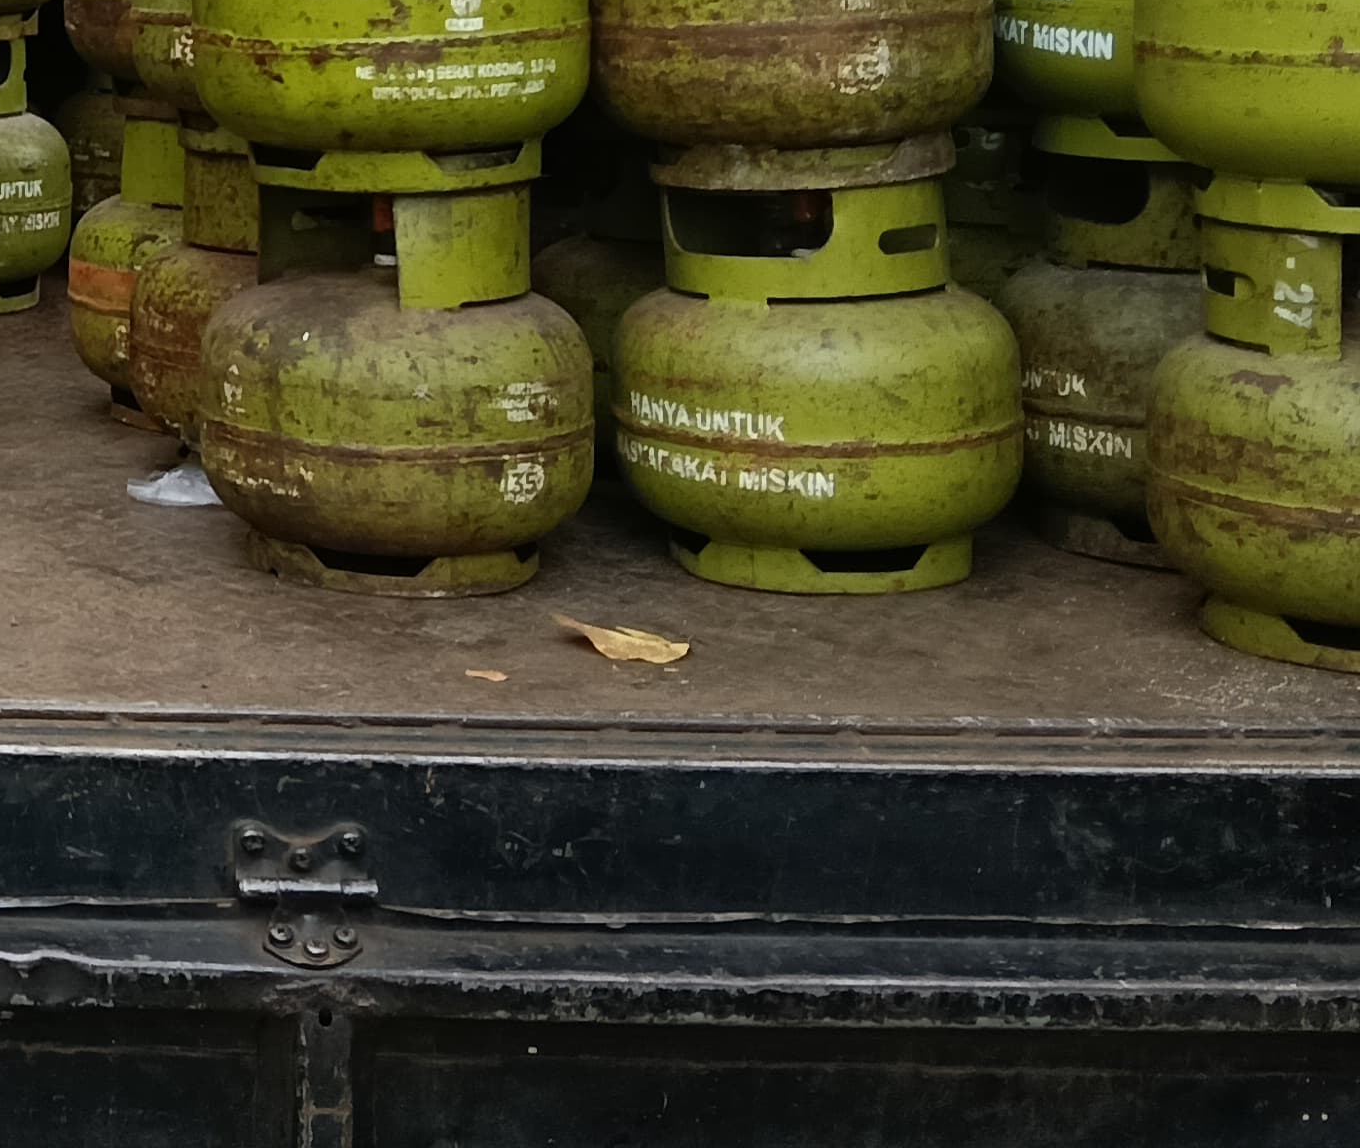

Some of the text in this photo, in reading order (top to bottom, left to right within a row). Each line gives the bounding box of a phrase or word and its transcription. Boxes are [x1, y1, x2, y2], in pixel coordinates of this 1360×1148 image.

[1032, 22, 1113, 61] MISKIN
[630, 390, 786, 442] HANYA UNTUK
[1047, 419, 1132, 460] MISKIN
[738, 467, 835, 499] MISKIN
